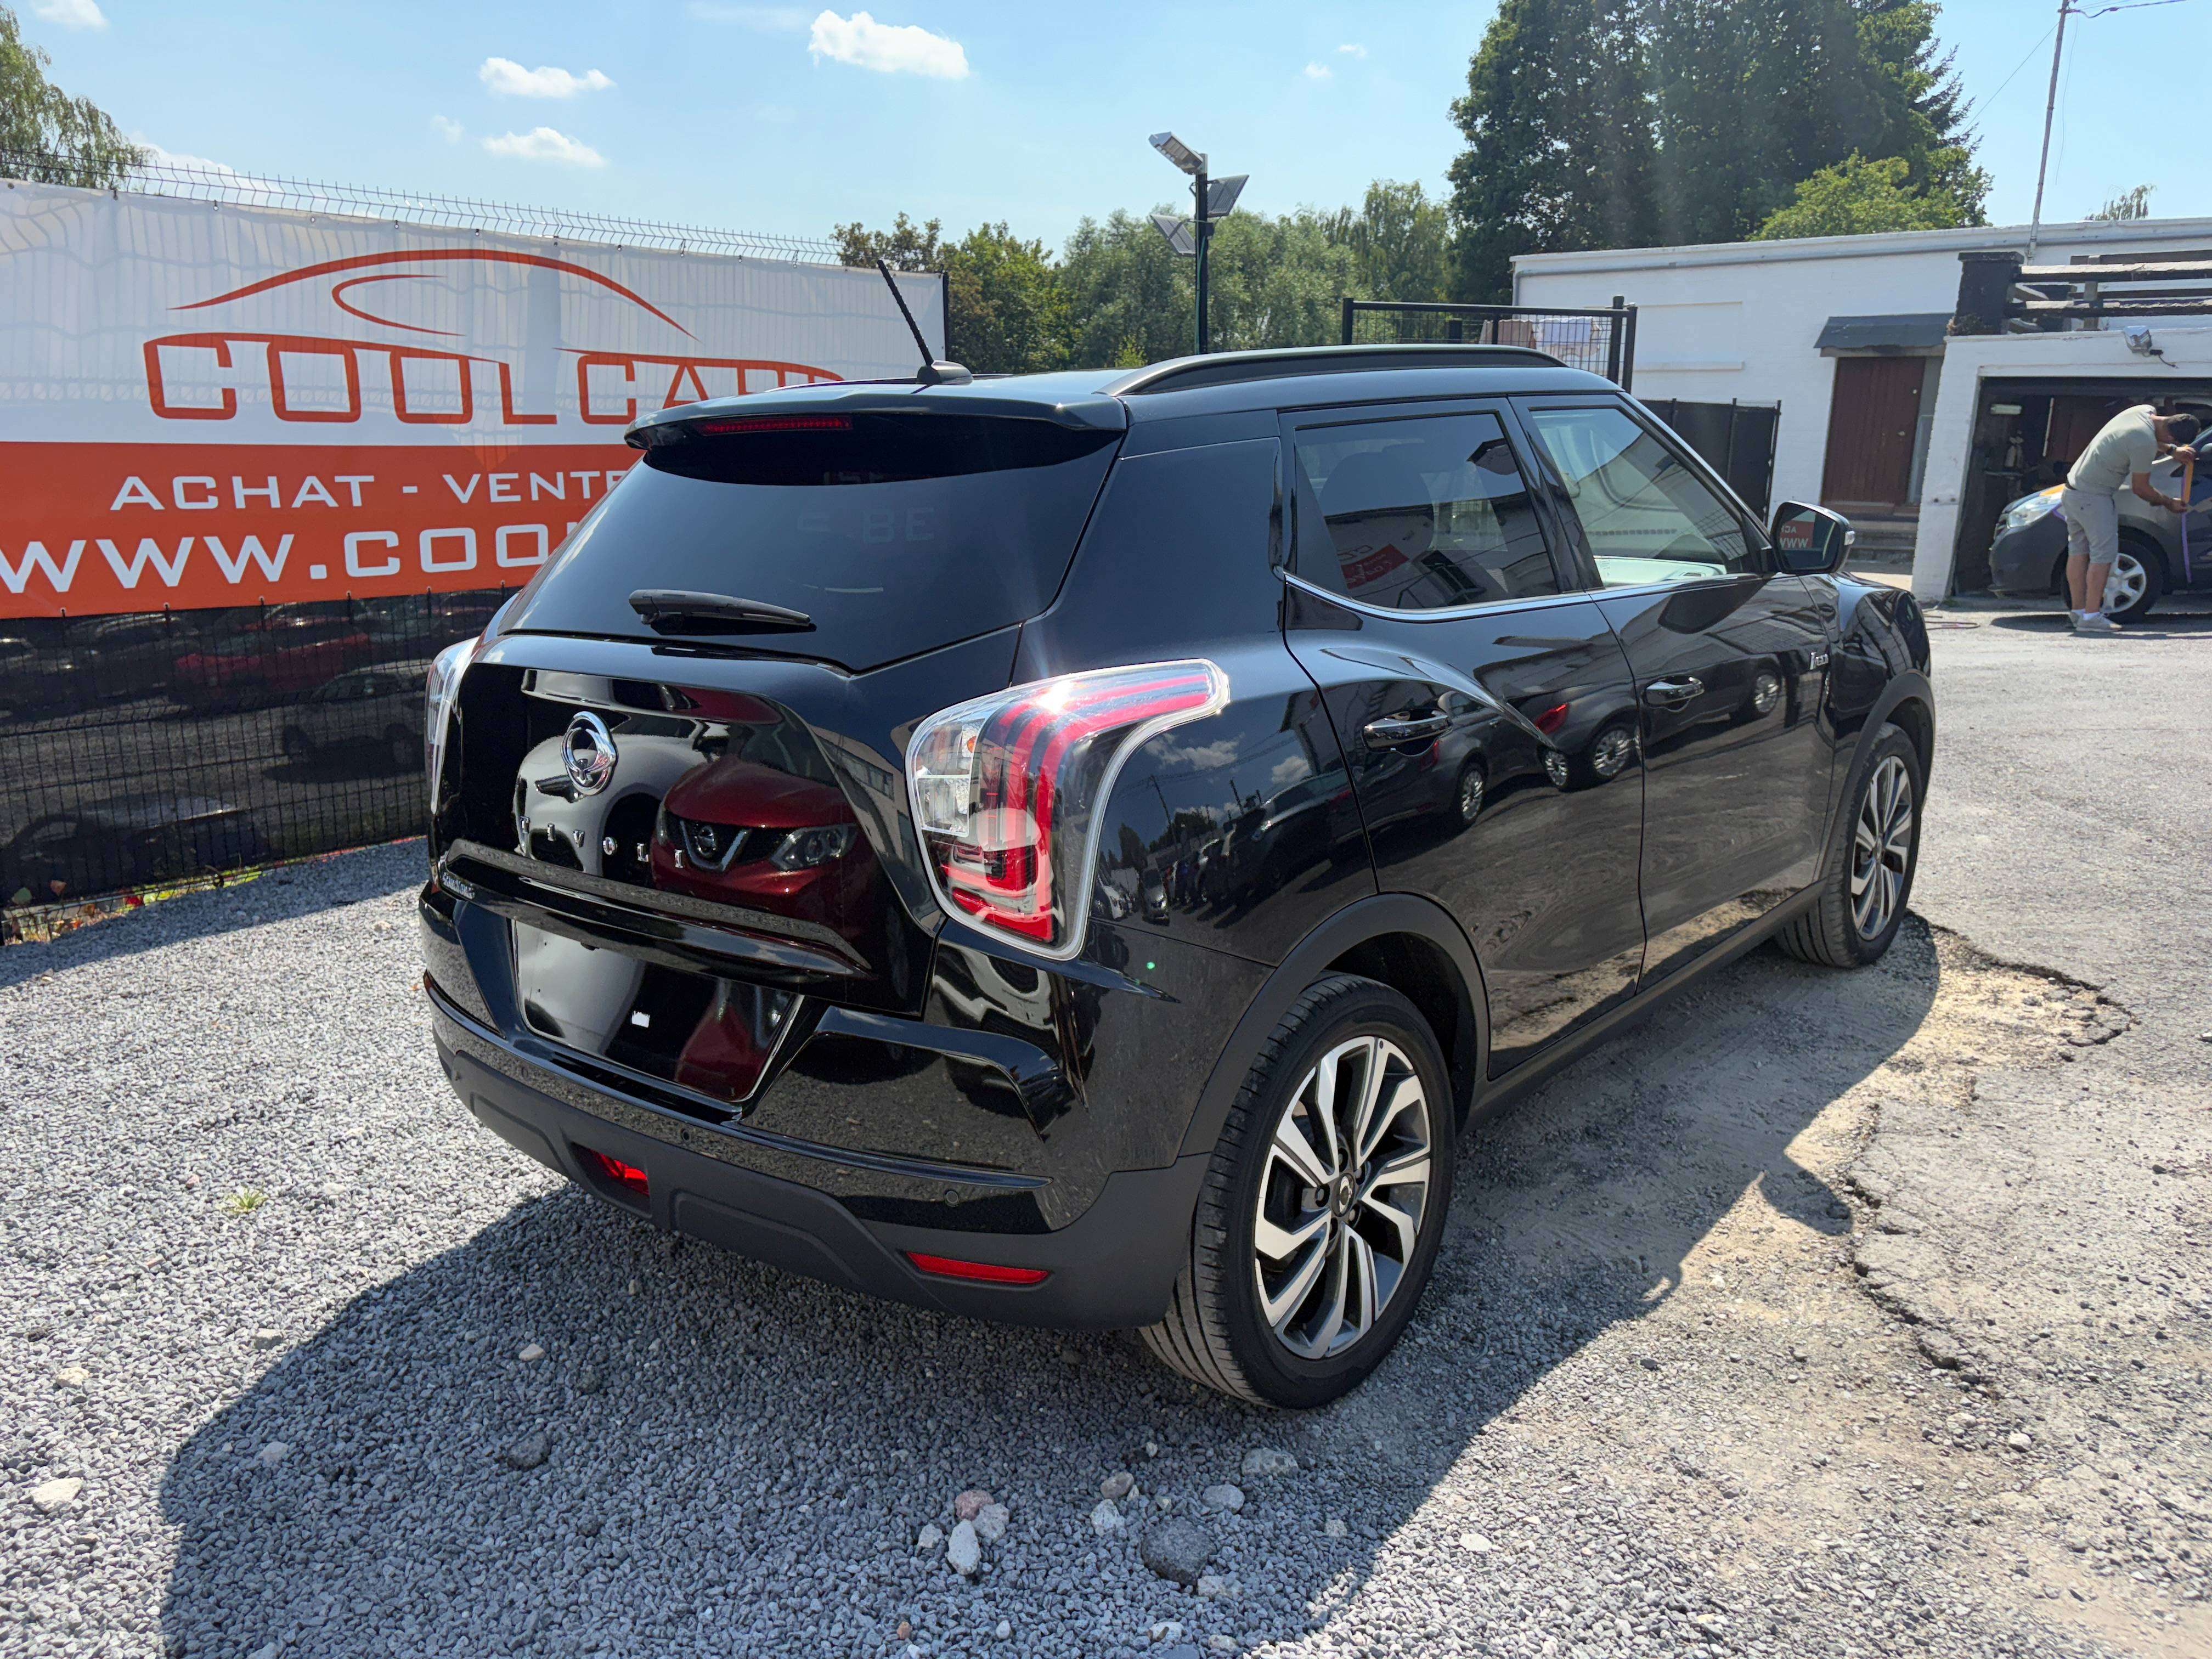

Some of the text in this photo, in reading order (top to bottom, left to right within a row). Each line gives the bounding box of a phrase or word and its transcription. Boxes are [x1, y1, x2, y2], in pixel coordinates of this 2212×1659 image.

[143, 332, 557, 426] COOL
[110, 475, 375, 511] ACHAT
[0, 521, 578, 594] WWW.COO
[520, 815, 684, 869] TIVOLI
